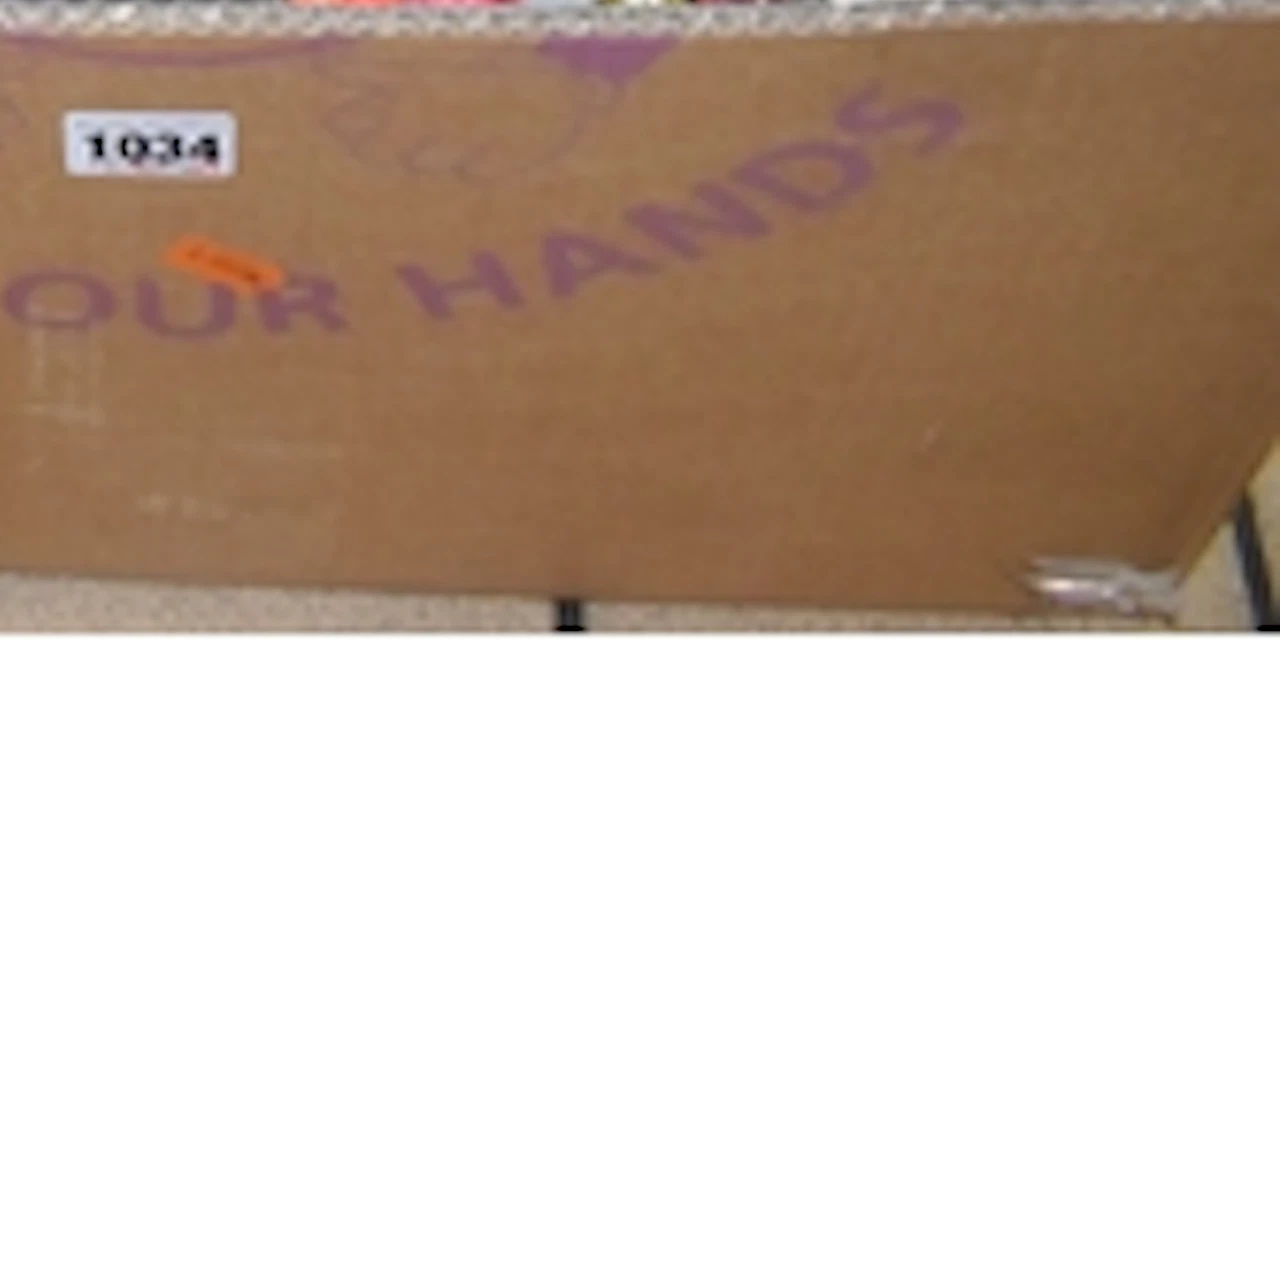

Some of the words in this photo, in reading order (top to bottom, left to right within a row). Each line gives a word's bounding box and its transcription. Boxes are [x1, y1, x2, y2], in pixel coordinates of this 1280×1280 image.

[0, 266, 350, 342] OUR
[395, 78, 976, 326] HANDS
[80, 122, 226, 170] 1034
